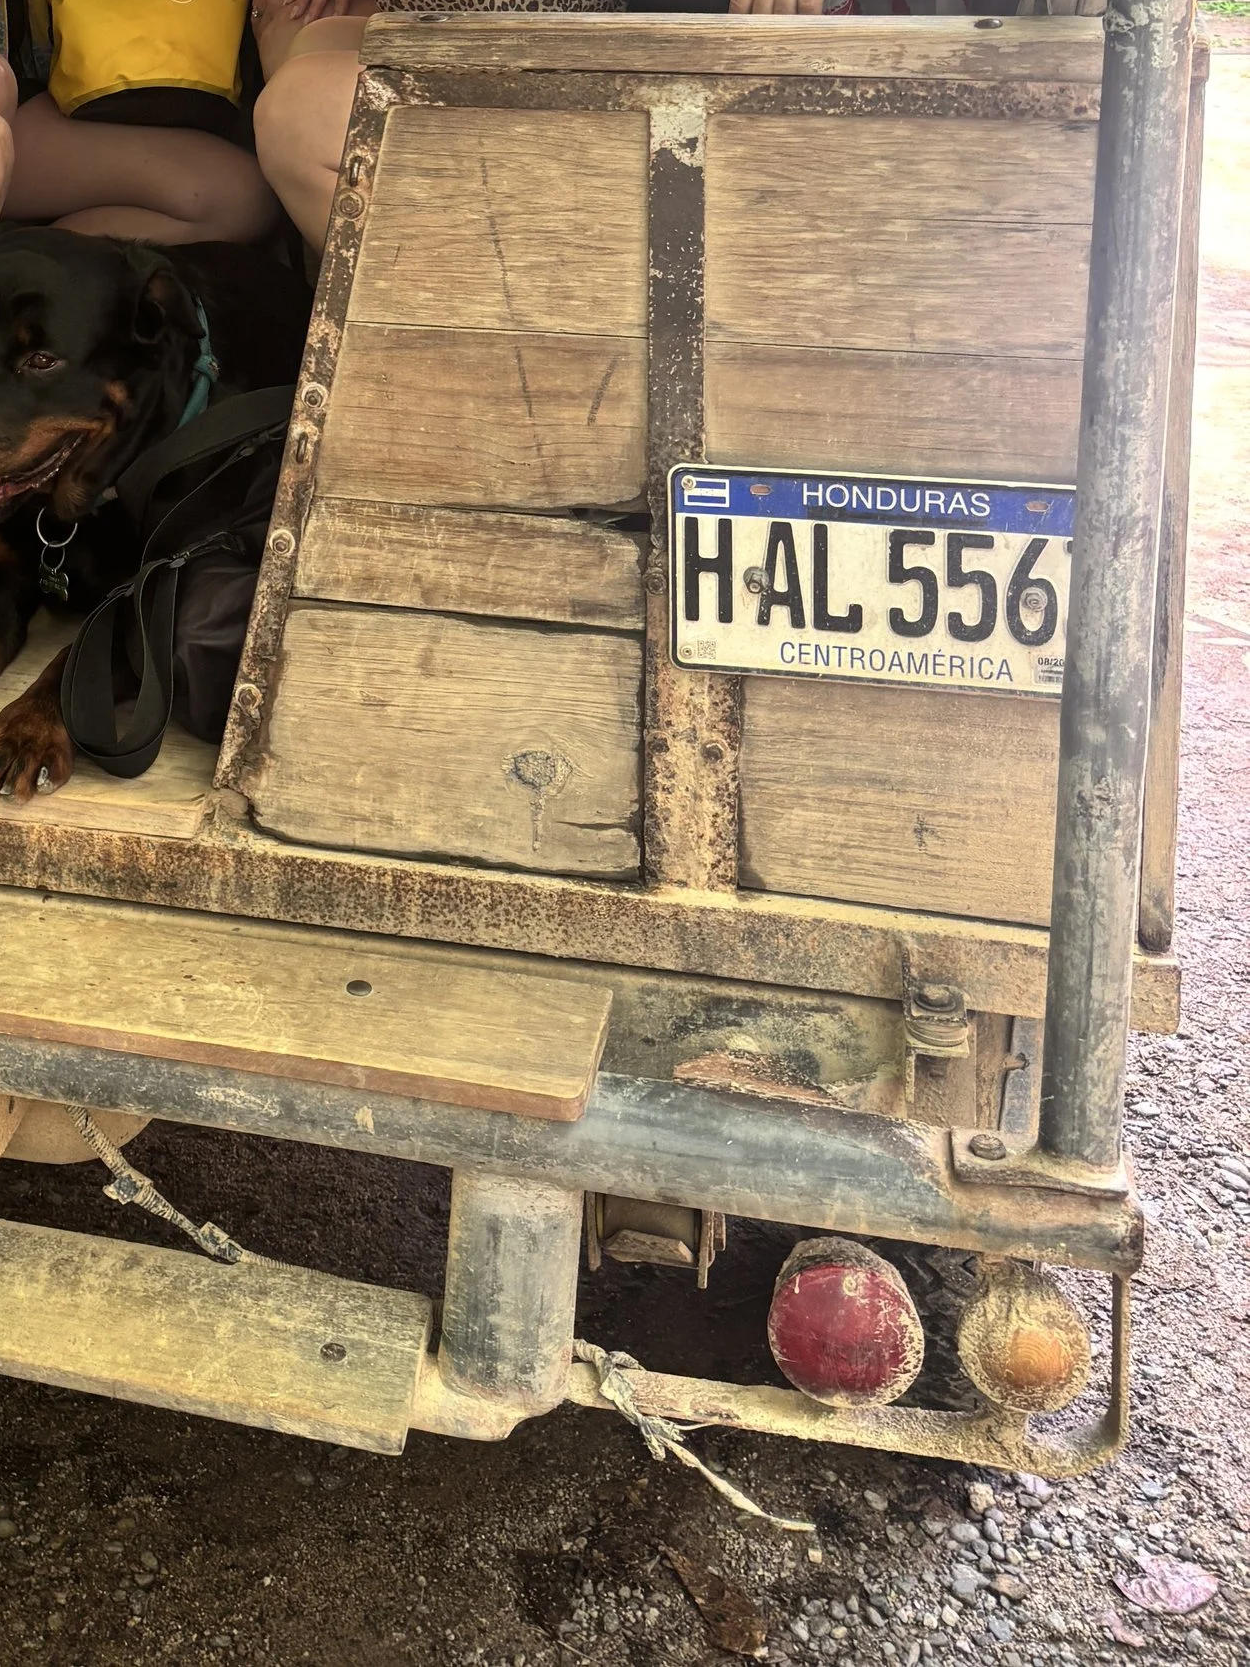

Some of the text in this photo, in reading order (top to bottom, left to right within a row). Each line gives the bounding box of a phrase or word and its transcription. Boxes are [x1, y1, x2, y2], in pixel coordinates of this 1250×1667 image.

[802, 483, 991, 516] HONDURAS
[684, 516, 1073, 647] HAL 556
[780, 641, 1014, 683] CENTROAMÉRICA
